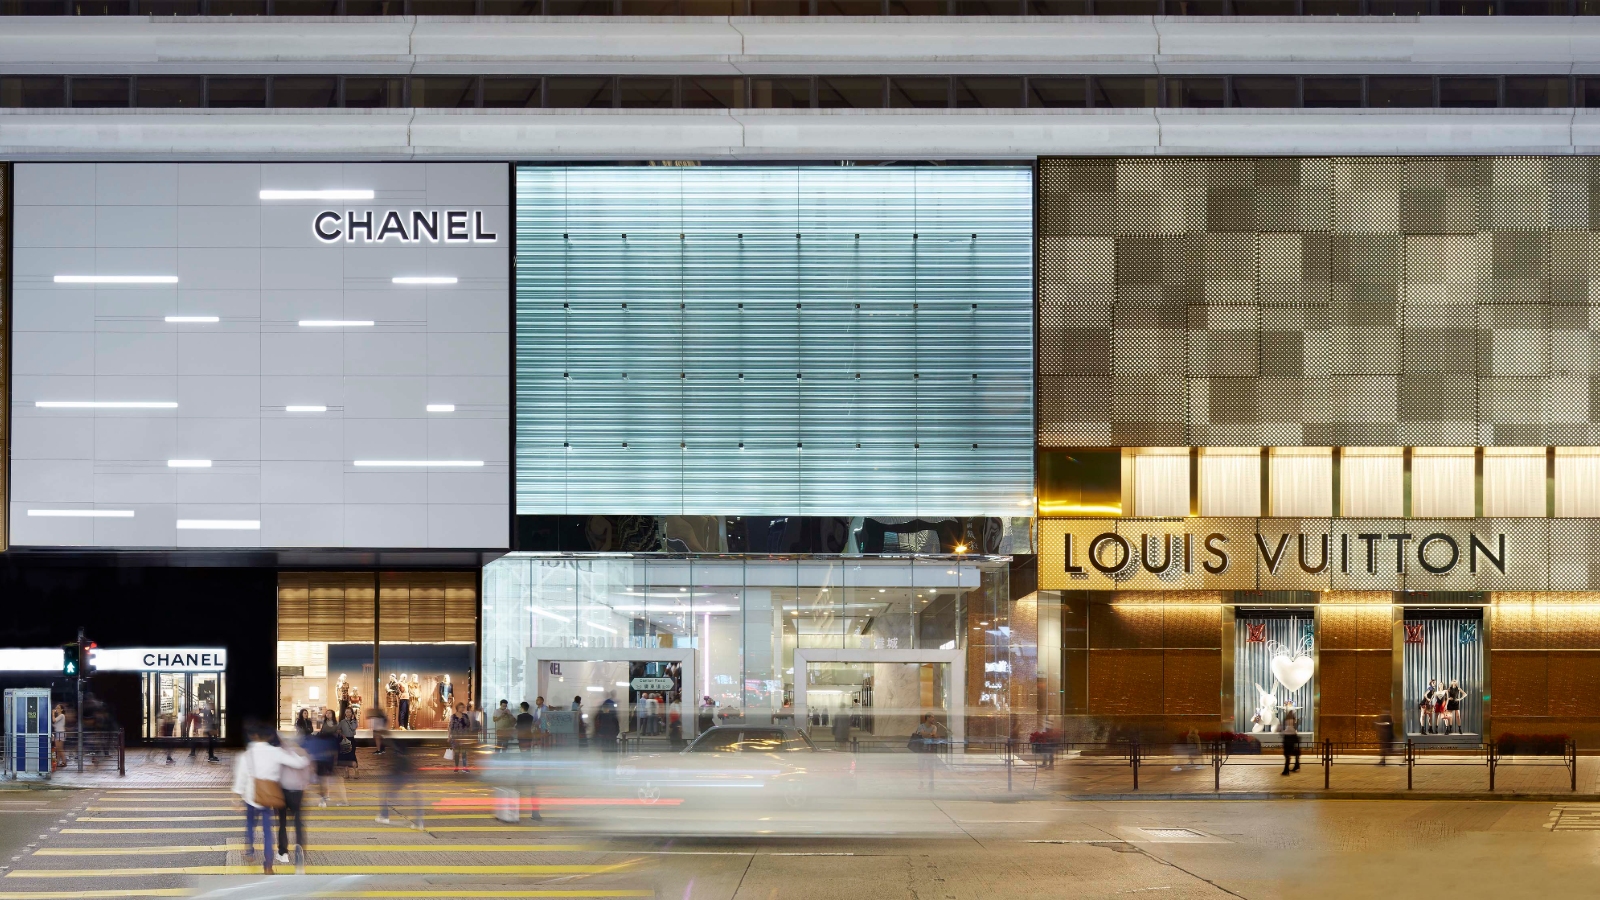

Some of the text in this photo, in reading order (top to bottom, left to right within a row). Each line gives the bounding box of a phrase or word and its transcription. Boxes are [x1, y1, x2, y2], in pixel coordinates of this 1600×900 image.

[314, 210, 497, 241] CHANEL
[1064, 531, 1506, 574] LOUIS VUITTON
[143, 653, 224, 666] CHANEL
